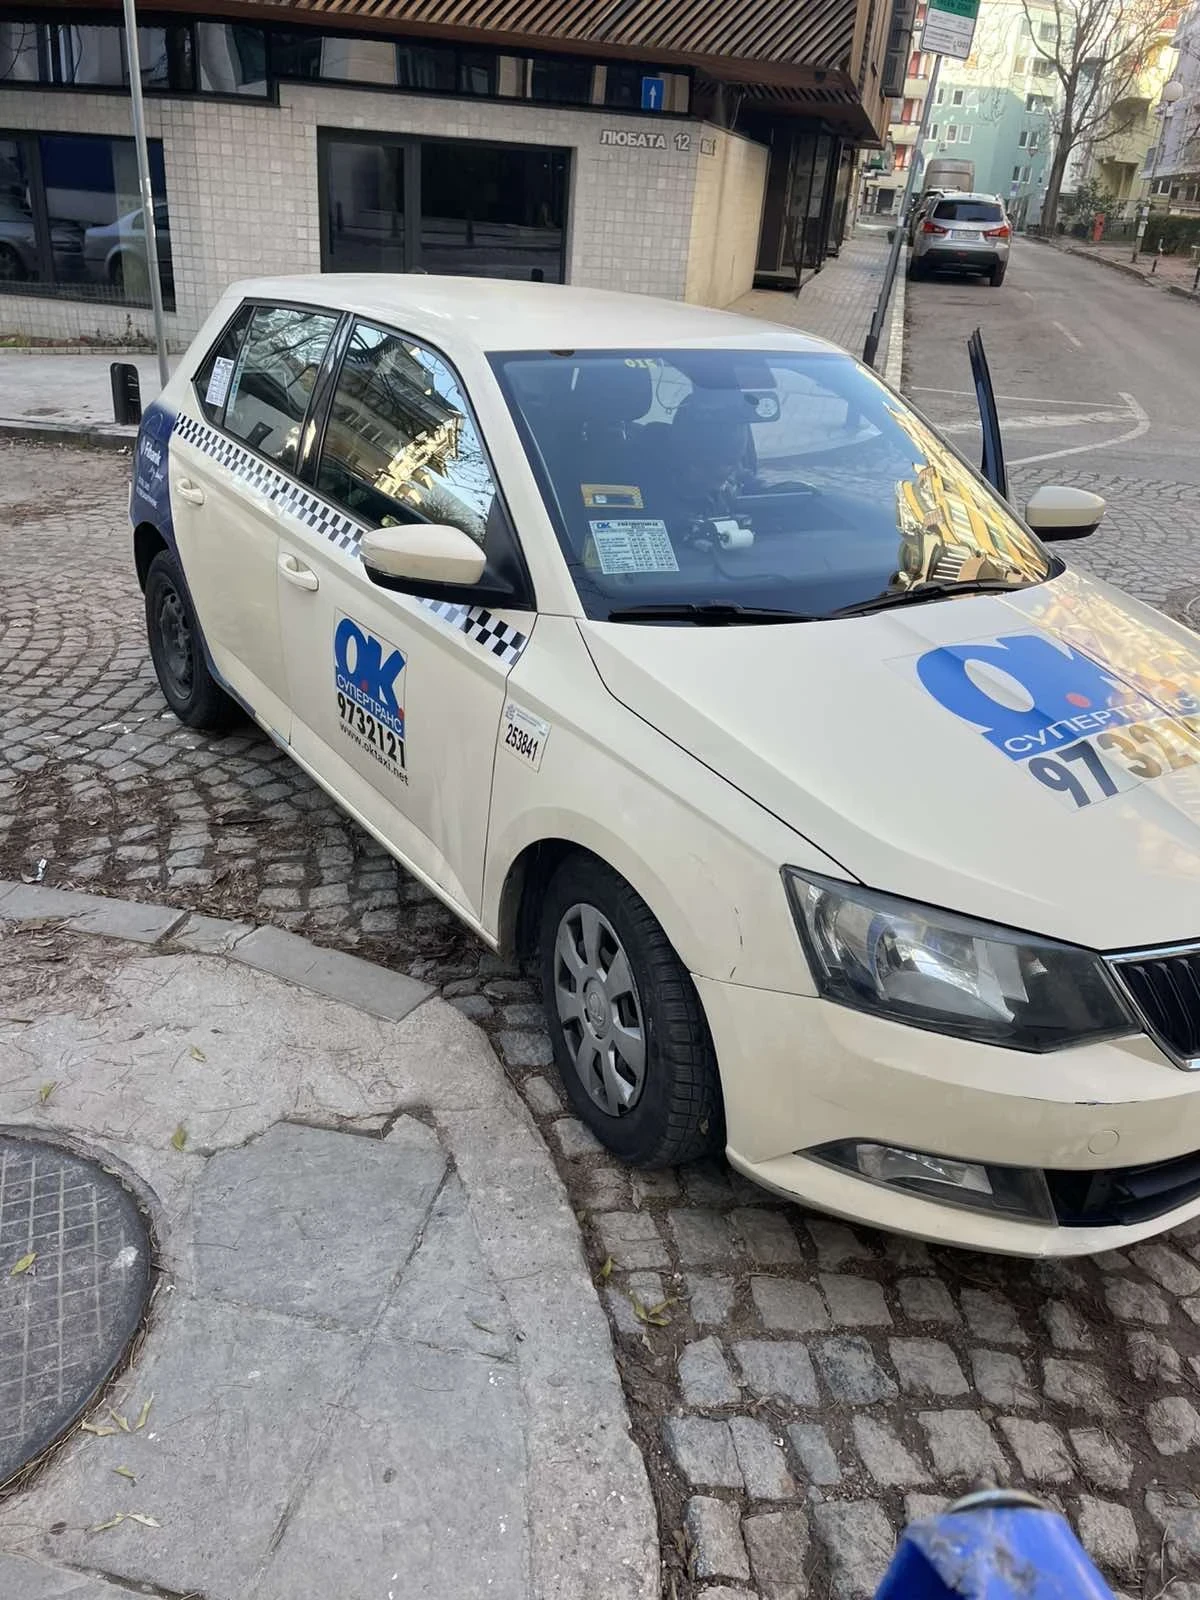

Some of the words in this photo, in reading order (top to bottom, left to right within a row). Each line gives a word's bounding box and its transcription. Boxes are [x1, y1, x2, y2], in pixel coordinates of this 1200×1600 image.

[600, 130, 667, 149] ЛЮБАТА
[674, 132, 690, 151] 12
[335, 618, 406, 705] OK
[337, 674, 402, 733] СУПЕРТРАНС
[338, 691, 406, 769] 9732121
[340, 722, 409, 787] www.oktaxi.net
[505, 723, 538, 762] 253841
